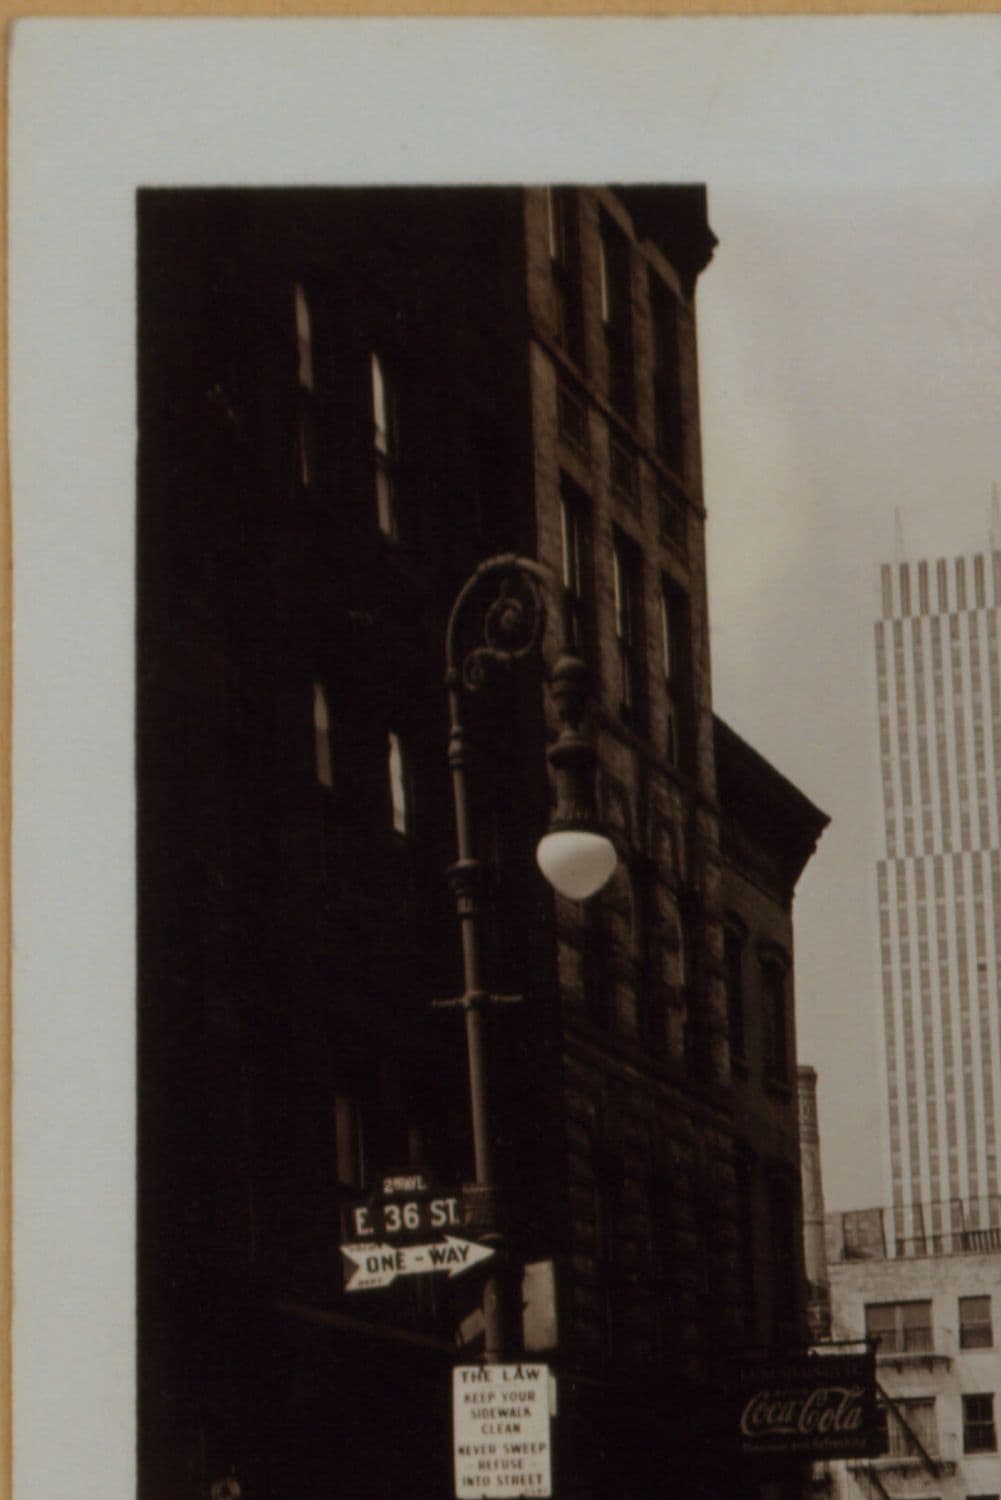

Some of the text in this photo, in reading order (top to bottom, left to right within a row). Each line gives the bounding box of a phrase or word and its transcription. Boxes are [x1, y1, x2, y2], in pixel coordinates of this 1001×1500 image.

[384, 1201, 420, 1233] 36
[461, 1367, 540, 1384] THE LAW
[463, 1390, 536, 1404] KEEP YOUR
[471, 1406, 532, 1419] SIDEWALK
[481, 1422, 521, 1435] CLEAN
[458, 1442, 547, 1456] NEVER SWEEP
[478, 1459, 522, 1471] REFUSE
[463, 1473, 542, 1488] INTO STREET
